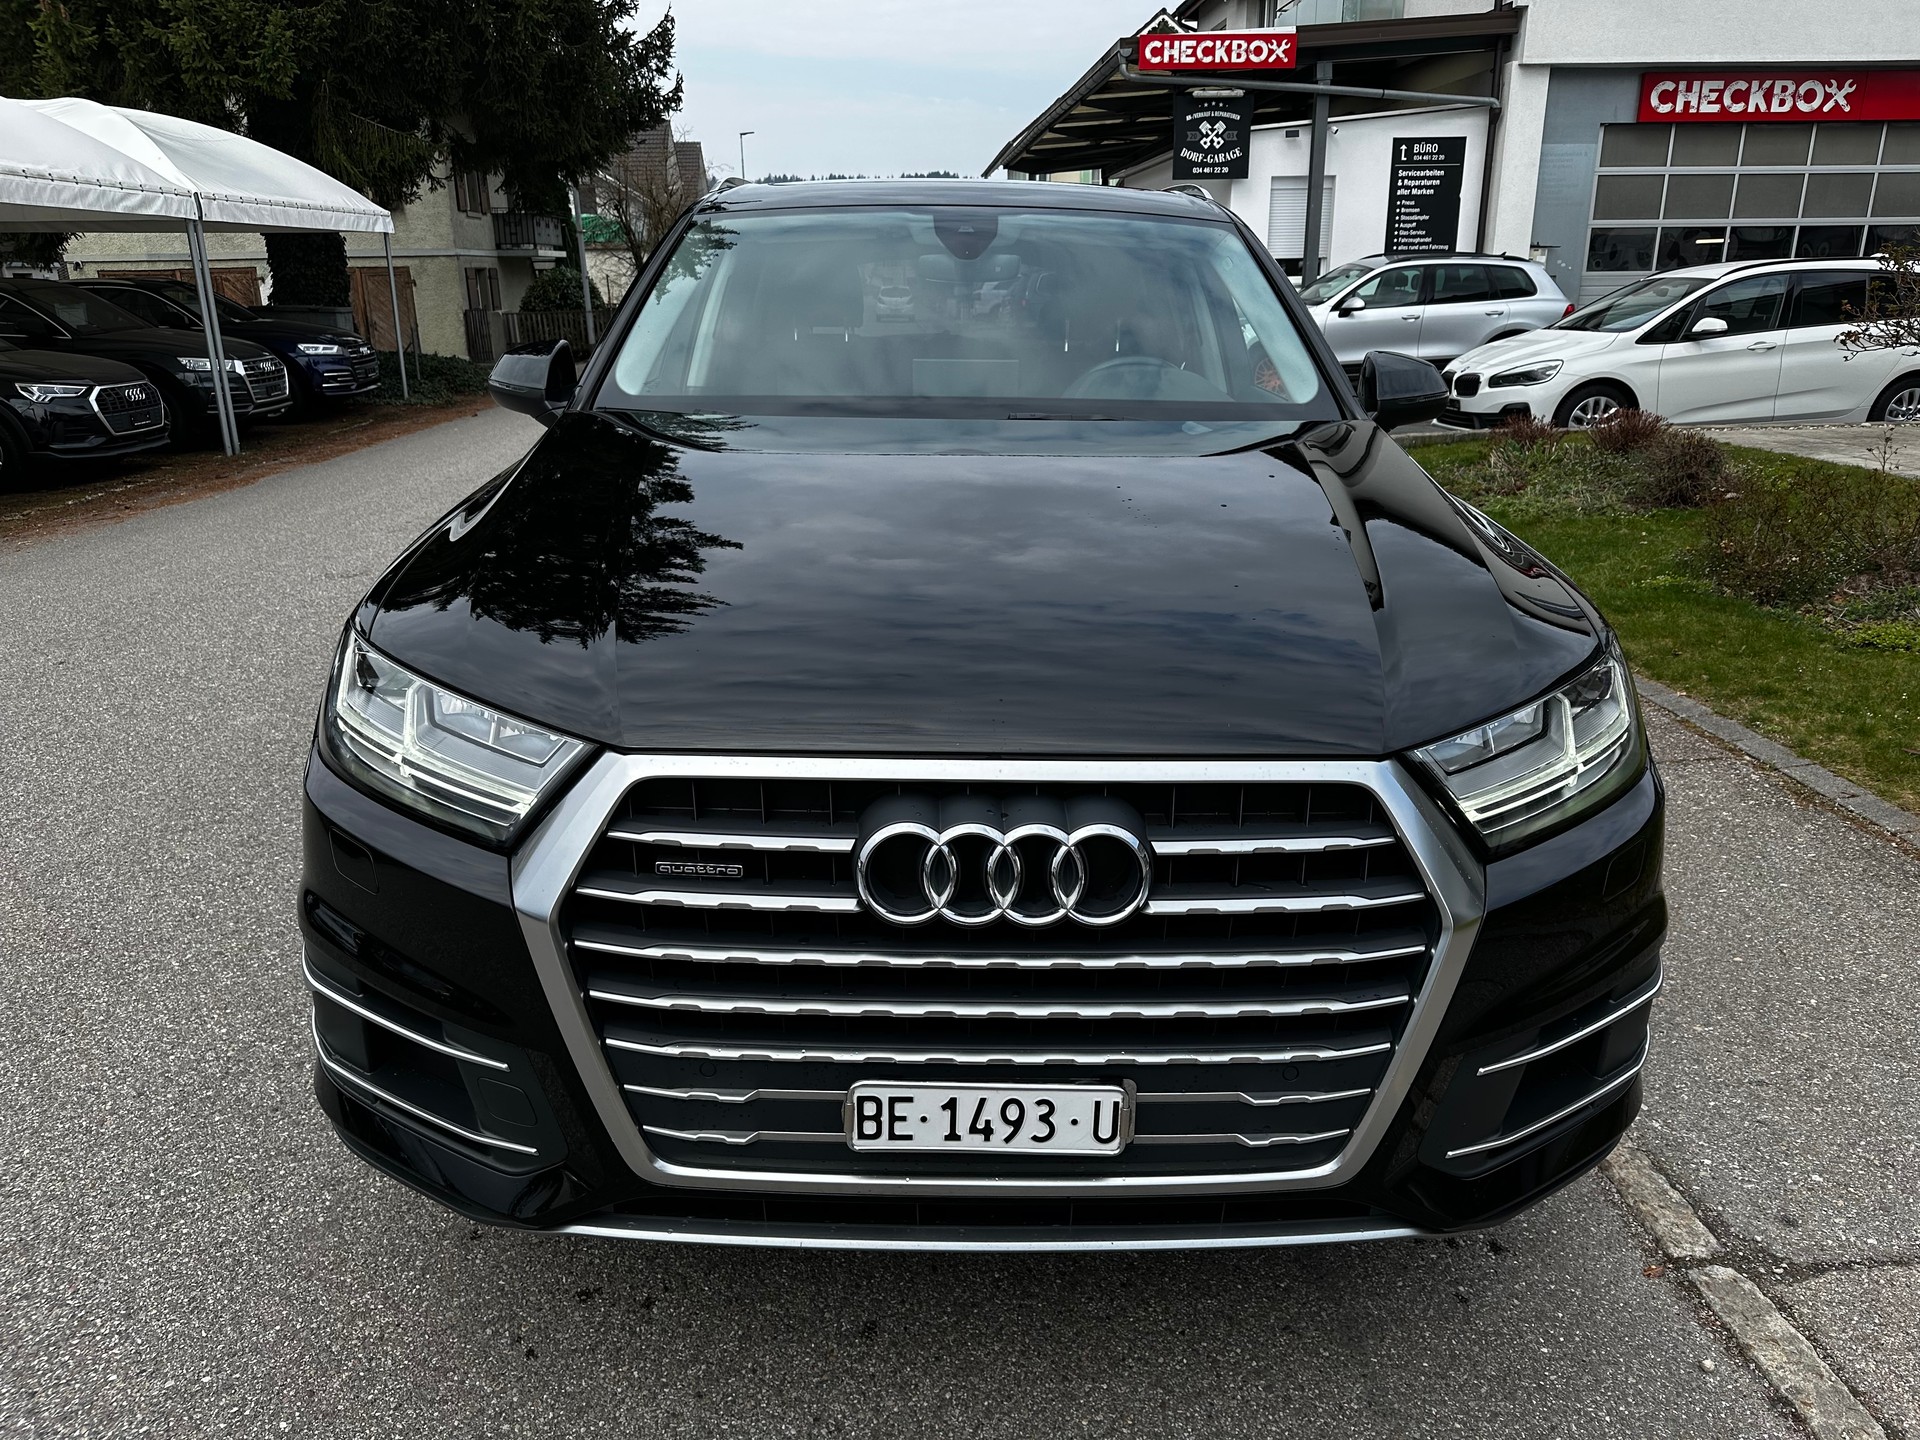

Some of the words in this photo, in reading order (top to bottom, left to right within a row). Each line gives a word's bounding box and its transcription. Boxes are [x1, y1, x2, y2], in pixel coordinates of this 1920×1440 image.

[1144, 39, 1291, 64] CHECKBOX
[1650, 79, 1857, 113] CHECKBOX
[1413, 142, 1438, 153] BÜRO
[1180, 147, 1243, 163] DORF-GARAGE
[1404, 179, 1440, 187] Reparaturen
[659, 865, 739, 875] quattro
